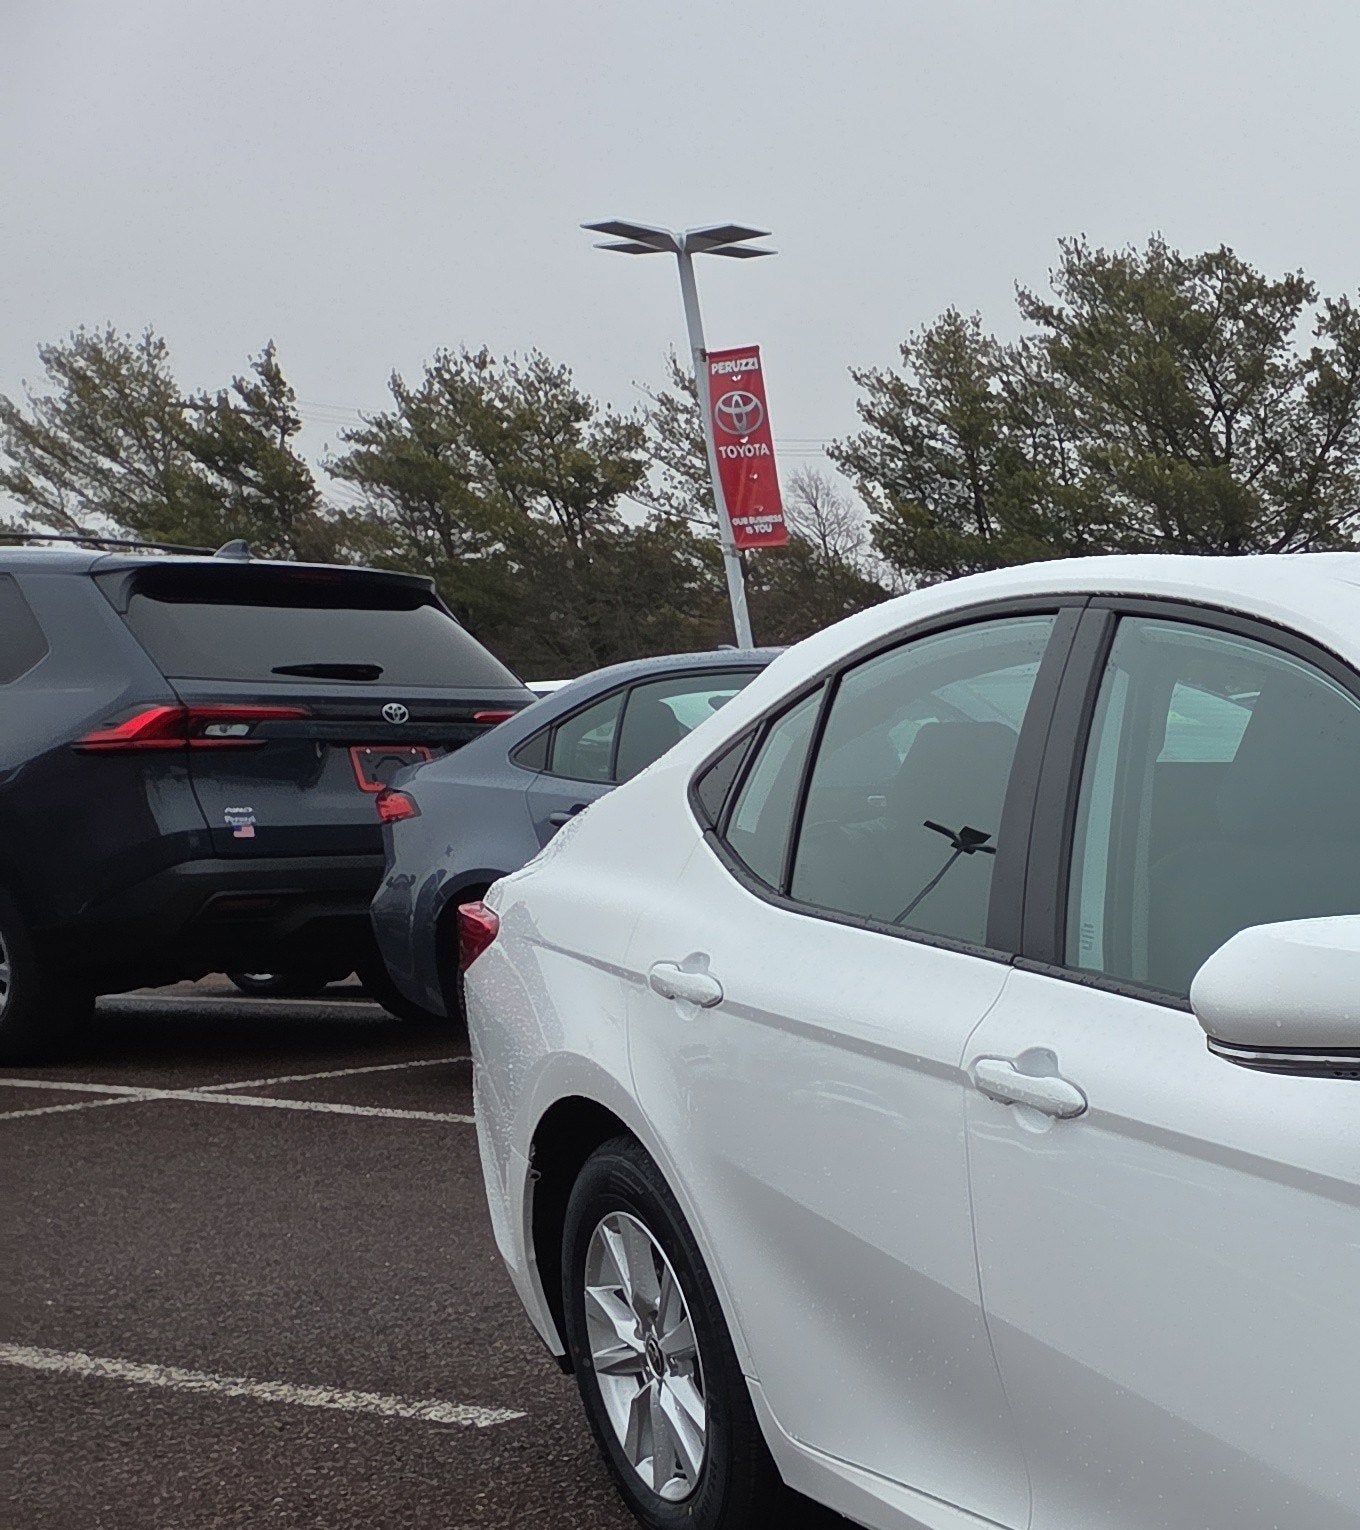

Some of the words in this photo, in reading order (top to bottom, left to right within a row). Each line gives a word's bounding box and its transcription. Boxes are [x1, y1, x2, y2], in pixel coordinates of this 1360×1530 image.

[711, 357, 759, 375] PERUZZI
[718, 443, 770, 459] TOYOTA
[754, 523, 772, 533] YOU
